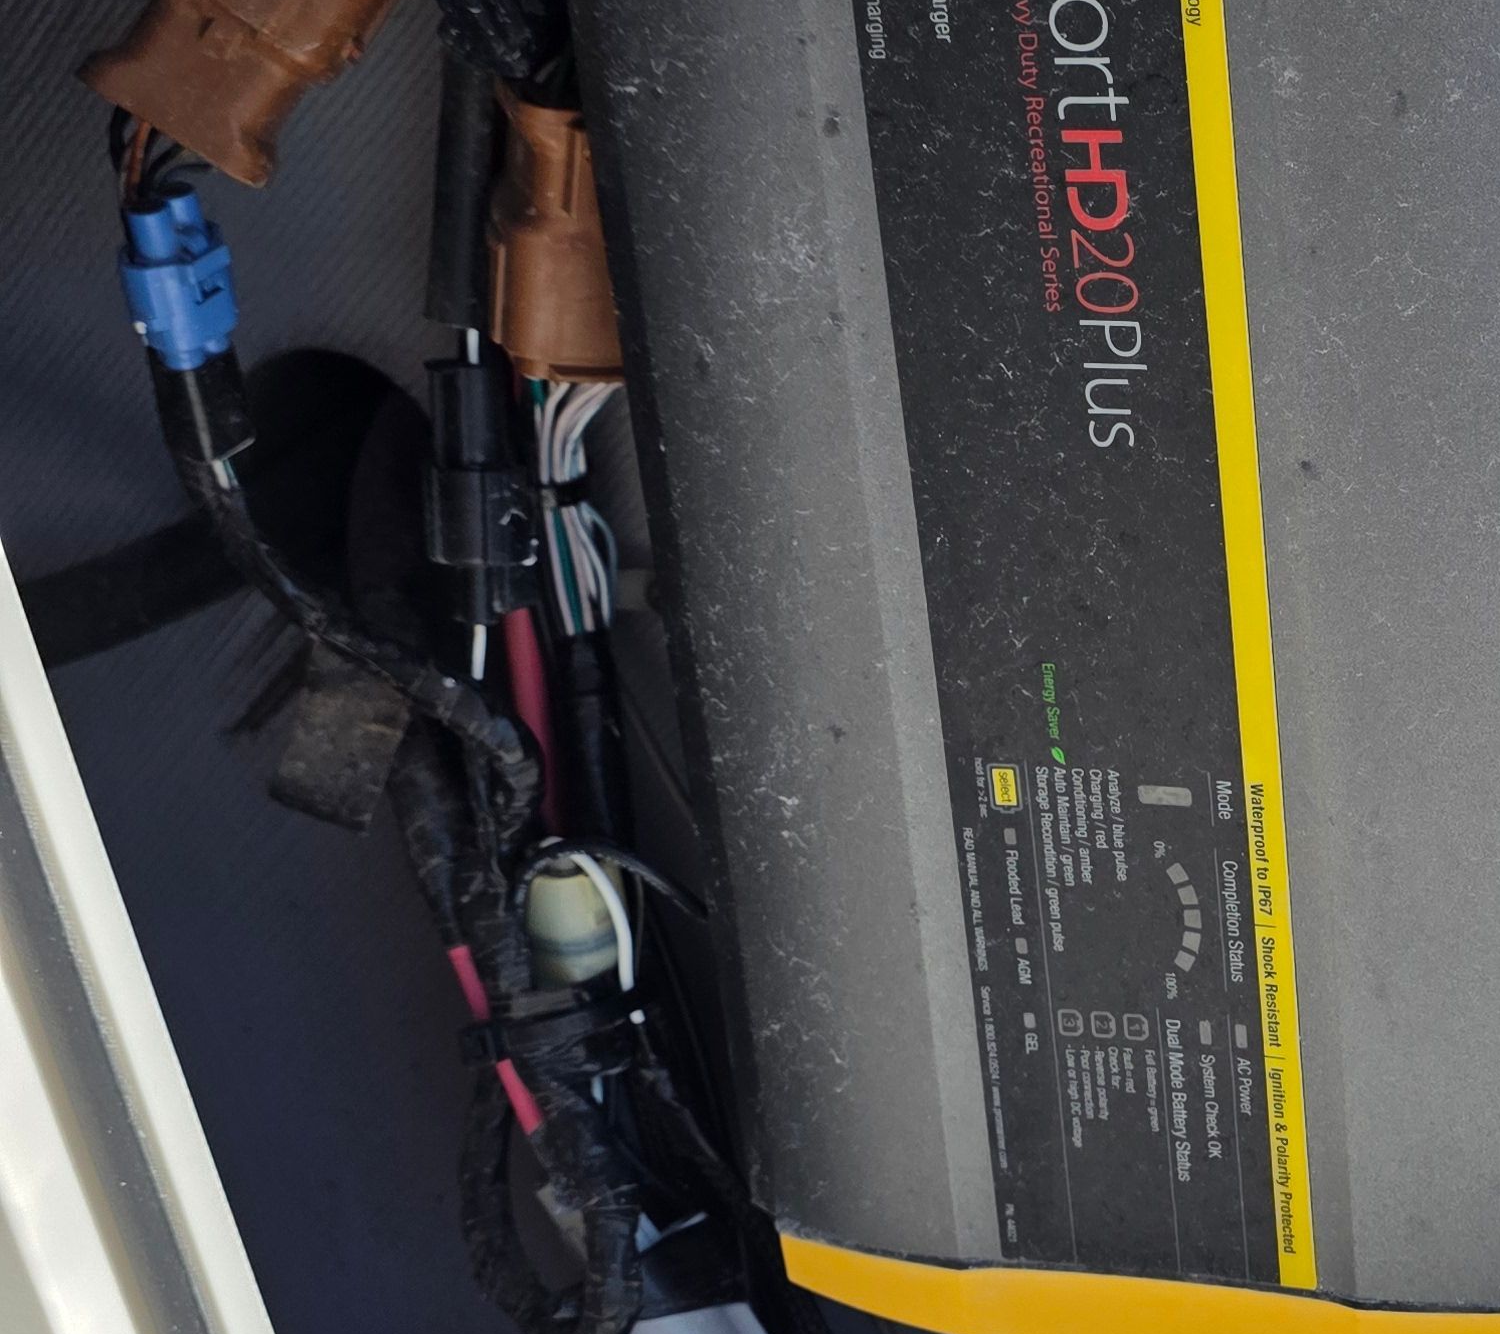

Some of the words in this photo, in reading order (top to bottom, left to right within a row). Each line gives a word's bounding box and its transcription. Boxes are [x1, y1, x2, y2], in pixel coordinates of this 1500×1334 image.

[1016, 32, 1041, 89] Duty
[1023, 96, 1057, 239] Recreational
[1039, 246, 1064, 312] Series
[1038, 662, 1057, 703] Energy
[1045, 706, 1061, 739] Saver
[997, 771, 1013, 803] select
[1032, 765, 1051, 810] Storage
[1052, 766, 1067, 792] Auto
[1085, 768, 1105, 819] Charging
[1103, 769, 1122, 813] Analyze
[1067, 767, 1089, 838] Conditioning
[1214, 780, 1233, 820] Mode
[961, 827, 974, 849] READ
[1055, 795, 1073, 844] Maintain
[1111, 824, 1125, 848] blue
[1247, 783, 1268, 862] Waterproof
[1039, 812, 1058, 878] Recondition
[1094, 830, 1108, 848] red
[1152, 840, 1165, 858] 0%
[965, 851, 979, 887] MANUAL
[1004, 849, 1021, 894] Flooded
[1058, 853, 1074, 886] green
[1077, 847, 1093, 884] amber
[1110, 850, 1128, 881] pulse
[1255, 867, 1269, 880] to
[969, 889, 981, 907] AND
[971, 908, 983, 924] ALL
[1010, 897, 1025, 925] Lead
[1044, 887, 1060, 919] green
[1217, 860, 1242, 937] Completion
[1256, 885, 1272, 915] IP67
[973, 925, 988, 971] WARNINGS
[1048, 921, 1065, 952] pulse
[1016, 957, 1031, 984] AGM
[1227, 939, 1246, 983] Status
[1260, 936, 1276, 979] Shock
[1163, 971, 1177, 1000] 100%
[1062, 1018, 1075, 1027] 3
[1095, 1020, 1107, 1028] 2
[1165, 1019, 1181, 1049] Dual
[1263, 983, 1282, 1048] Resistant
[1023, 1032, 1038, 1055] GEL
[1167, 1051, 1185, 1089] Mode
[1198, 1053, 1216, 1098] System
[1236, 1057, 1250, 1075] AC
[1238, 1077, 1253, 1115] Power
[1267, 1067, 1286, 1118] Ignition
[1168, 1091, 1189, 1138] Battery
[1203, 1101, 1220, 1138] Check
[1274, 1122, 1287, 1133] &
[1174, 1140, 1193, 1182] Status
[1207, 1140, 1221, 1159] OK
[1272, 1136, 1291, 1187] Polarity
[1279, 1191, 1296, 1254] Protected
